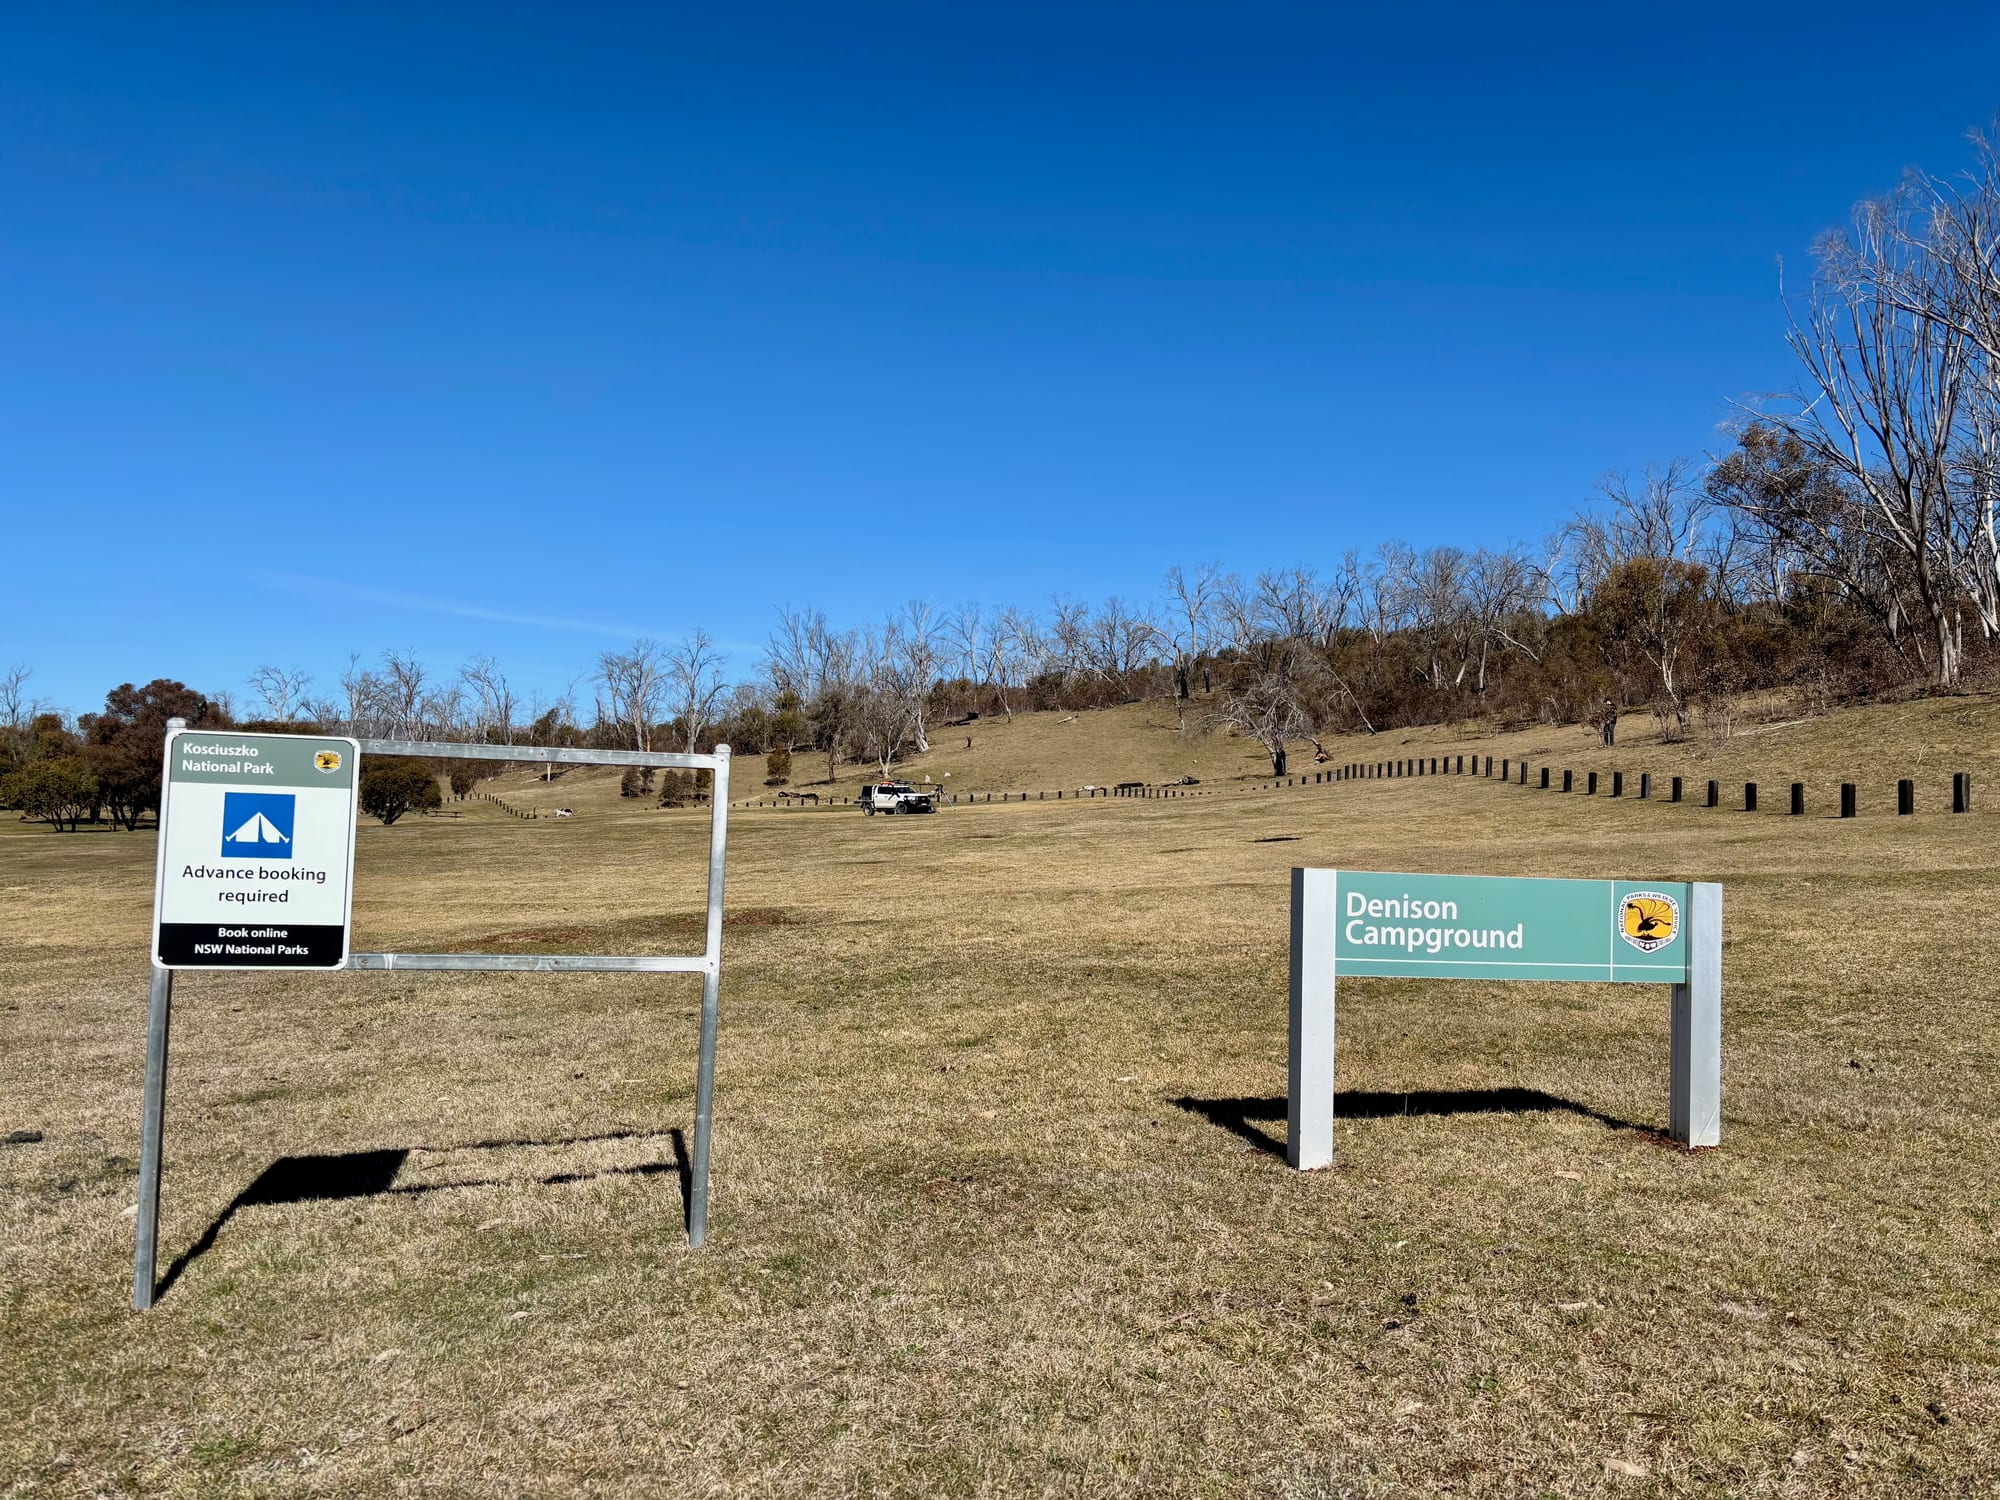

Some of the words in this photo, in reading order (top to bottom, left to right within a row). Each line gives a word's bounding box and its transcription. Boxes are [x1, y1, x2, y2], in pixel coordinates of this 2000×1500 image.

[183, 742, 259, 757] Kosciuszko
[182, 760, 241, 773] National
[243, 762, 274, 775] Park
[182, 865, 254, 880] Advance
[258, 866, 326, 884] booking
[218, 889, 289, 905] required
[1346, 892, 1458, 920] Denison
[218, 927, 249, 938] Book
[250, 928, 288, 938] online
[1345, 920, 1523, 953] Campground
[194, 943, 224, 954] NSW
[225, 944, 275, 955] National
[277, 945, 309, 955] Parks
